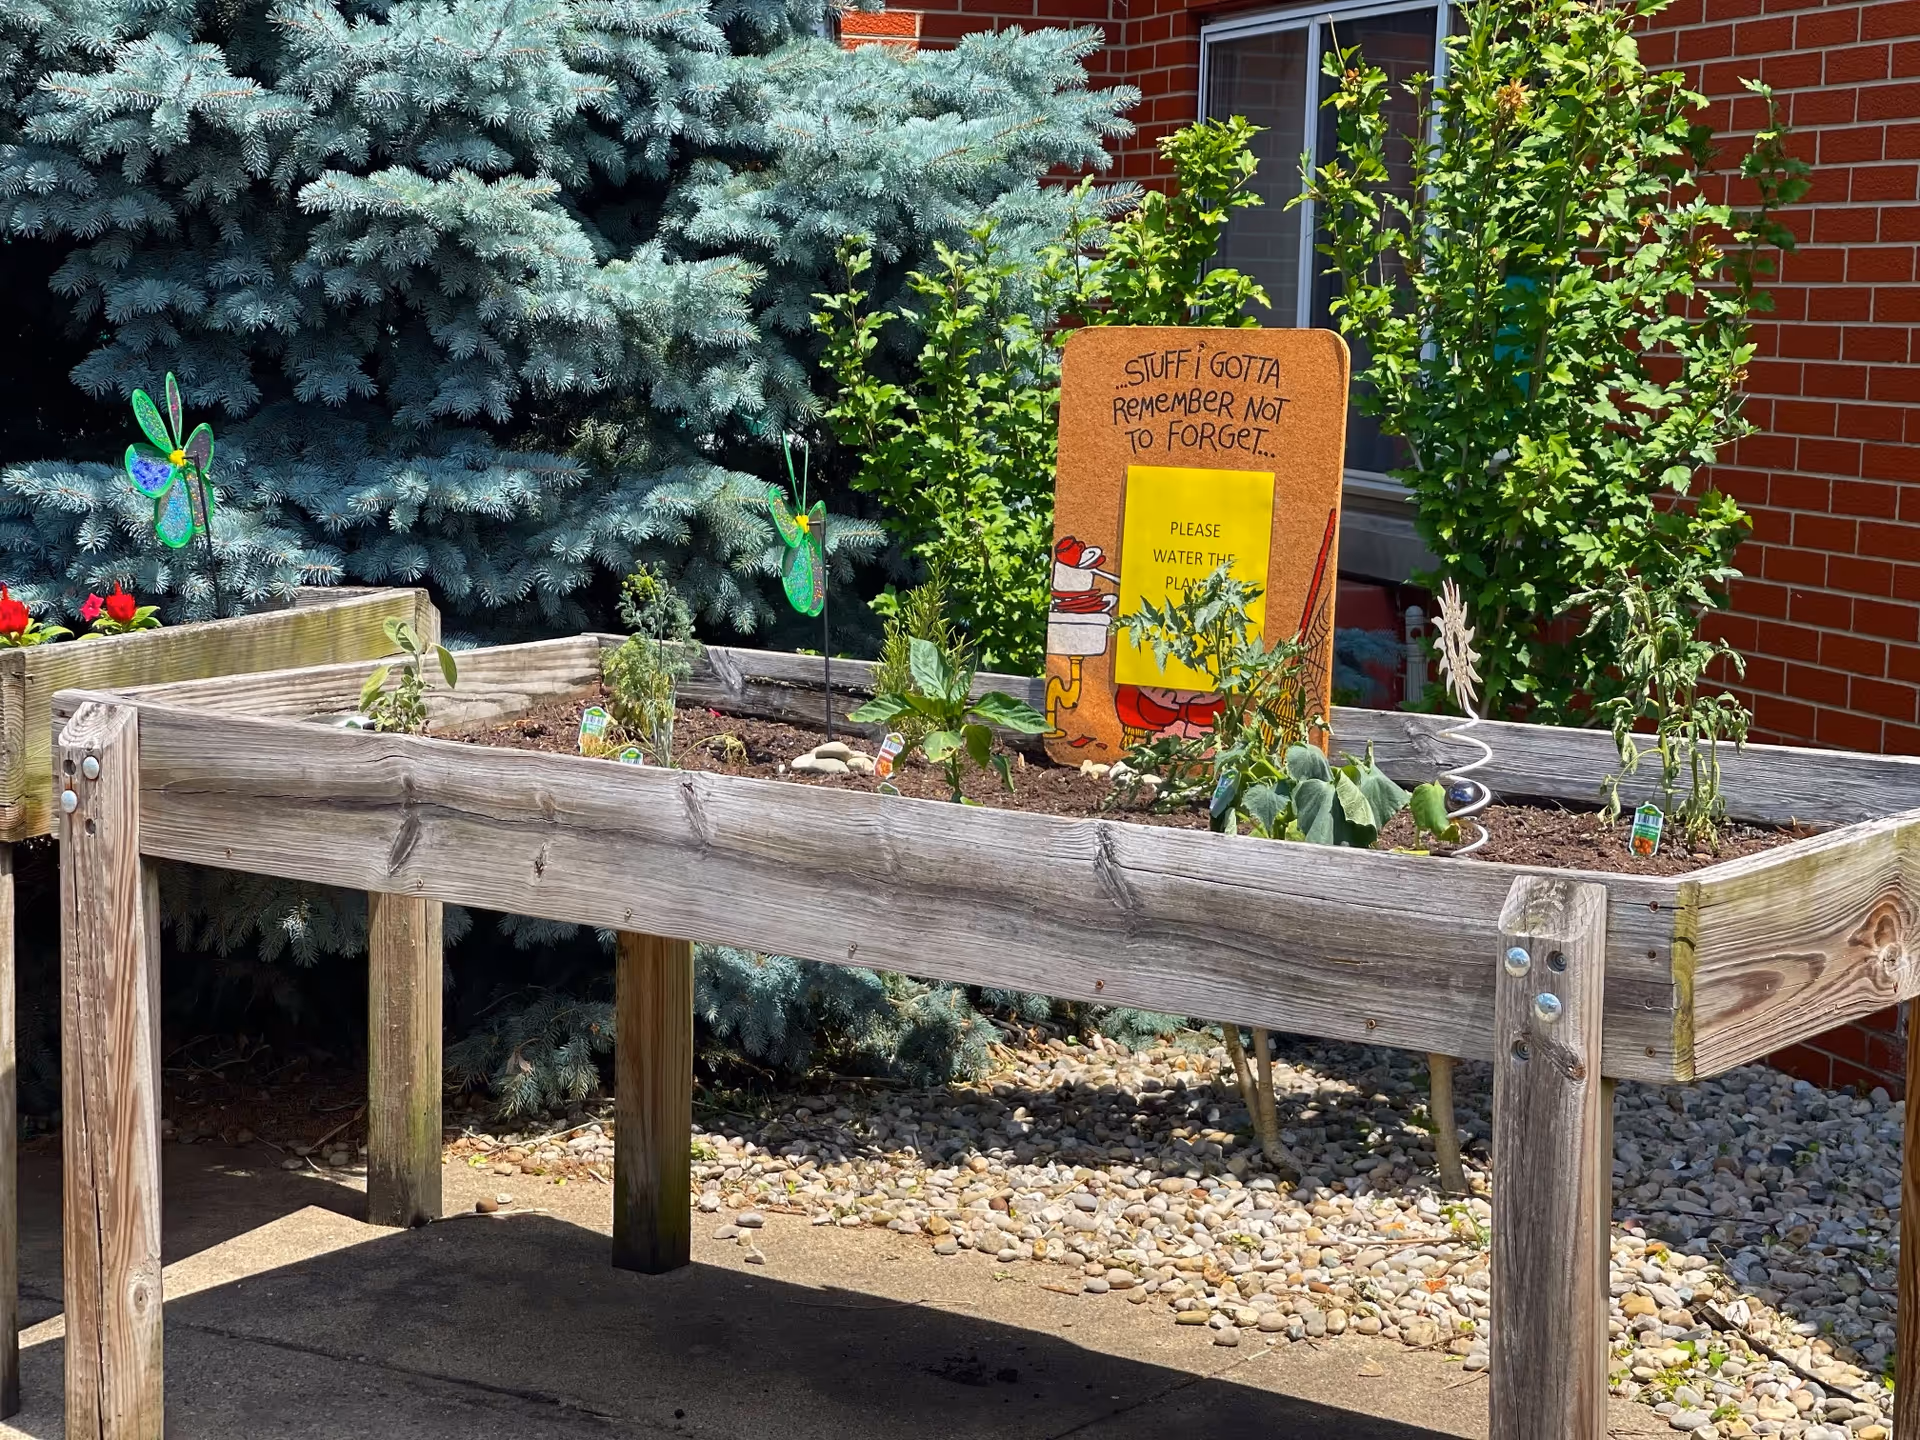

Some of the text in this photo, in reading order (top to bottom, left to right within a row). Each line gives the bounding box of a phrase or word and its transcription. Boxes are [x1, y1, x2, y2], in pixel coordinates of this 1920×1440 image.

[1210, 351, 1280, 388] GOTTA
[1244, 396, 1290, 424] NOT
[1125, 428, 1153, 454] TO
[1170, 522, 1221, 537] PLEASE
[1153, 549, 1203, 565] WATER
